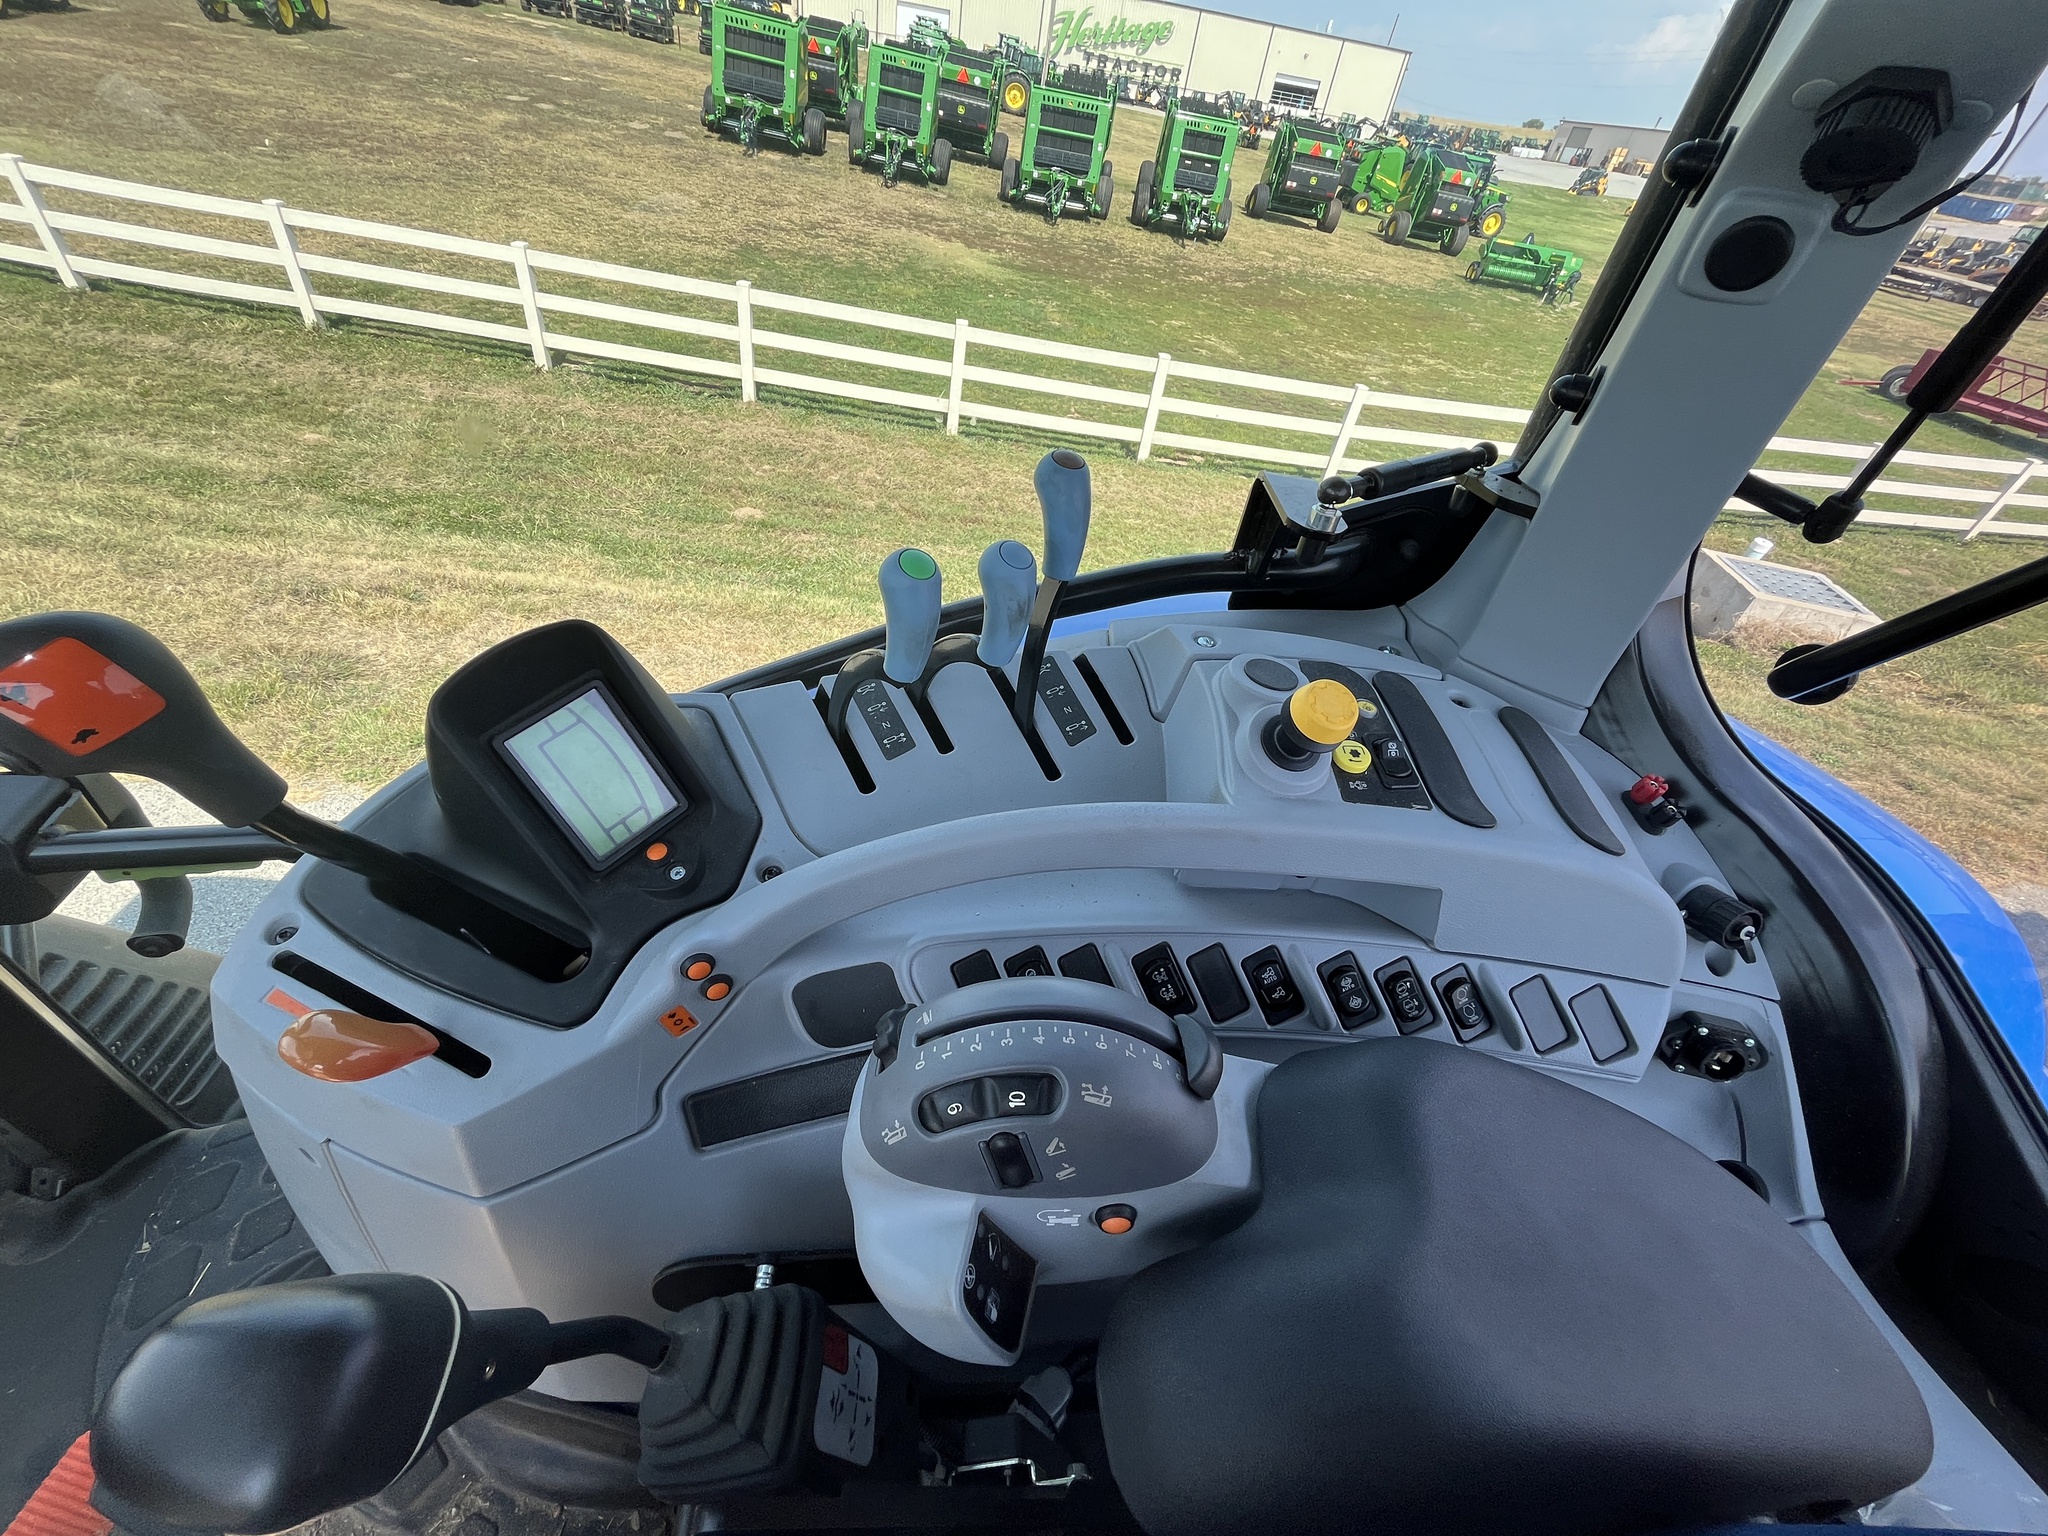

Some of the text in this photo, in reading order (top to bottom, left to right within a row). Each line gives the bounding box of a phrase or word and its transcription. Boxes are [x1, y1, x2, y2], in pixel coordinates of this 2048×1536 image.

[1050, 5, 1175, 57] Heritage
[1083, 50, 1182, 81] TRACTOR
[1263, 975, 1278, 985] AUTO
[1342, 984, 1356, 993] AUTO
[915, 1060, 925, 1070] 0
[941, 1051, 952, 1060] 1
[970, 1042, 982, 1052] 2
[1001, 1037, 1013, 1046] 3
[1032, 1035, 1045, 1044] 4
[1062, 1036, 1075, 1044] 5
[1095, 1041, 1108, 1050] 6
[1125, 1049, 1137, 1058] 7
[1152, 1060, 1163, 1070] 8
[1008, 1090, 1027, 1108] 10
[947, 1102, 963, 1116] 9
